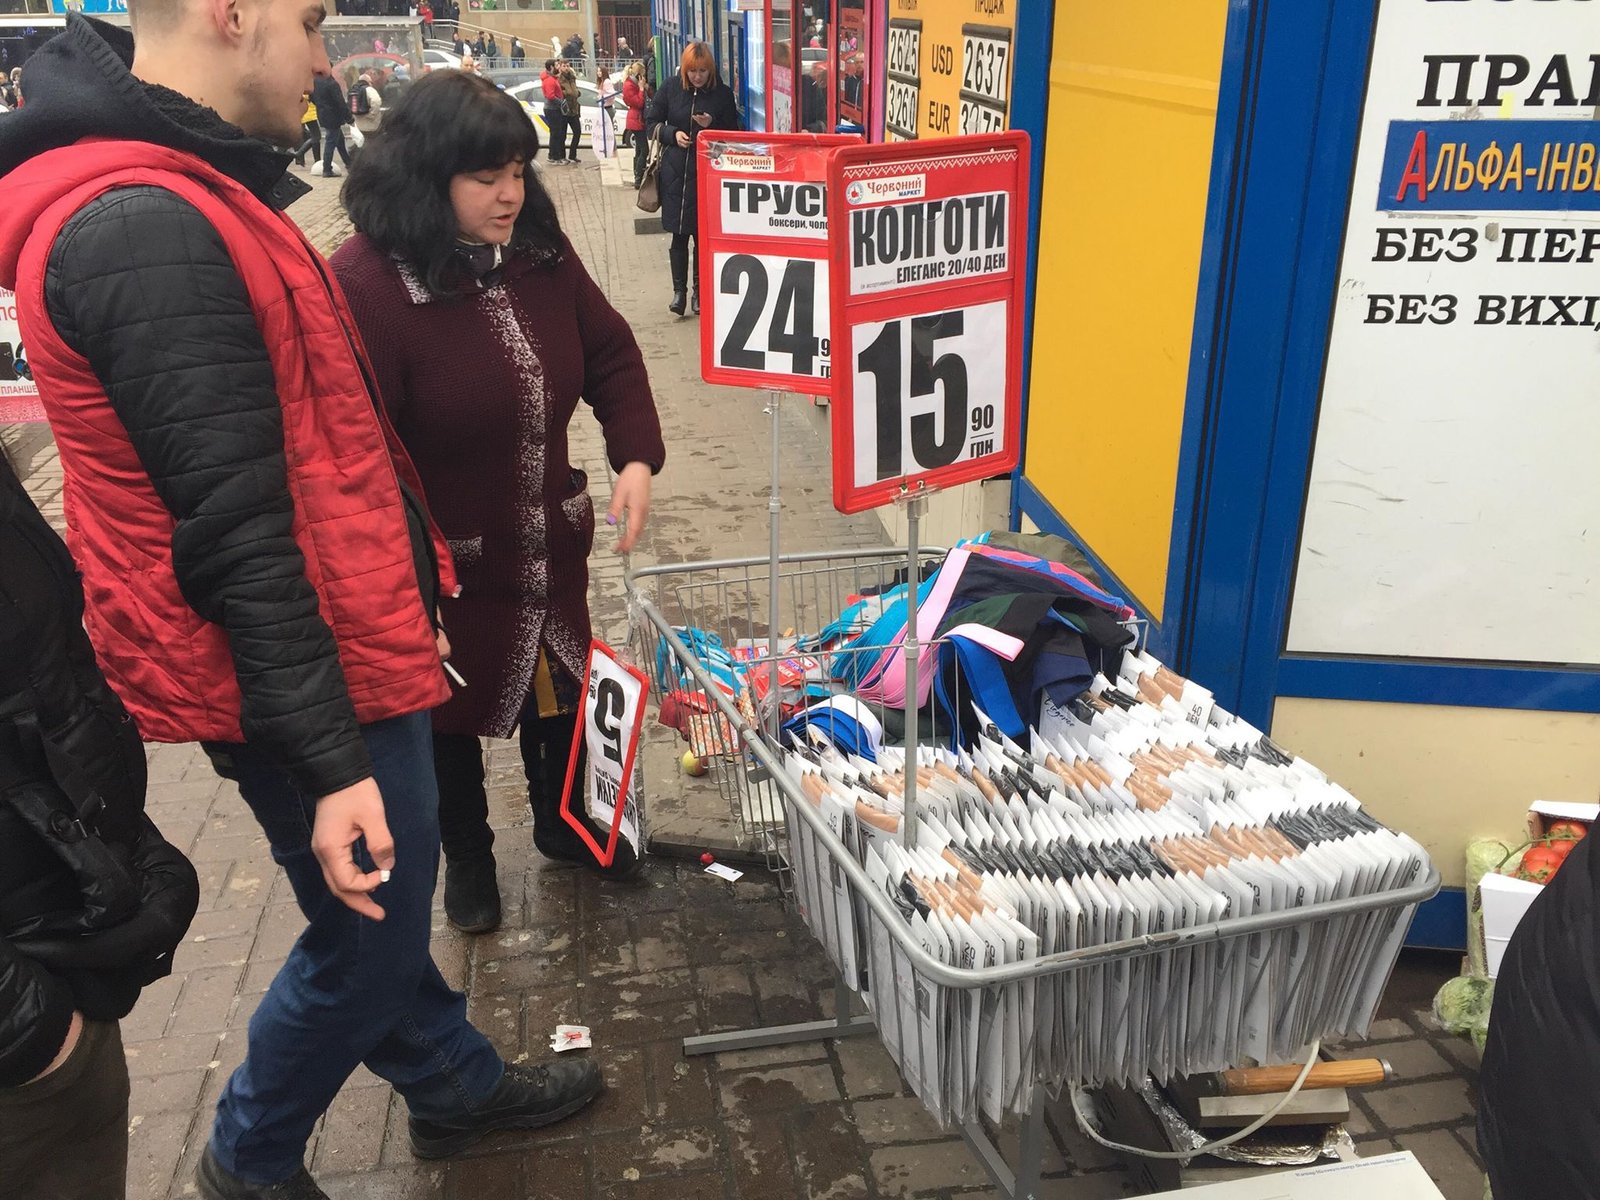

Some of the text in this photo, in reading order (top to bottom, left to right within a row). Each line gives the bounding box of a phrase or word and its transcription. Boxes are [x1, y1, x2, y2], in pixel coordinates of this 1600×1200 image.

[890, 30, 1006, 99] 2625 USD 2637
[888, 84, 915, 131] 3260
[928, 101, 950, 134] EUR
[727, 156, 772, 168] Червоний
[723, 182, 828, 217] ТРУС
[867, 177, 922, 197] Червоний
[898, 189, 921, 197] МАРКЕТ
[769, 216, 808, 229] боксери,
[853, 193, 1006, 268] КОЛГОТИ
[1371, 227, 1479, 263] БЕЗ
[897, 252, 1006, 284] ЕЛЕГАНС 20/40 ДЕН
[720, 254, 819, 375] 24
[1363, 294, 1600, 332] БЕЗ ВИХІ
[858, 310, 968, 481] 15
[971, 404, 994, 432] 90
[970, 438, 993, 459] грн
[594, 677, 625, 771] 5
[1192, 704, 1203, 717] 40
[964, 942, 976, 960] 20
